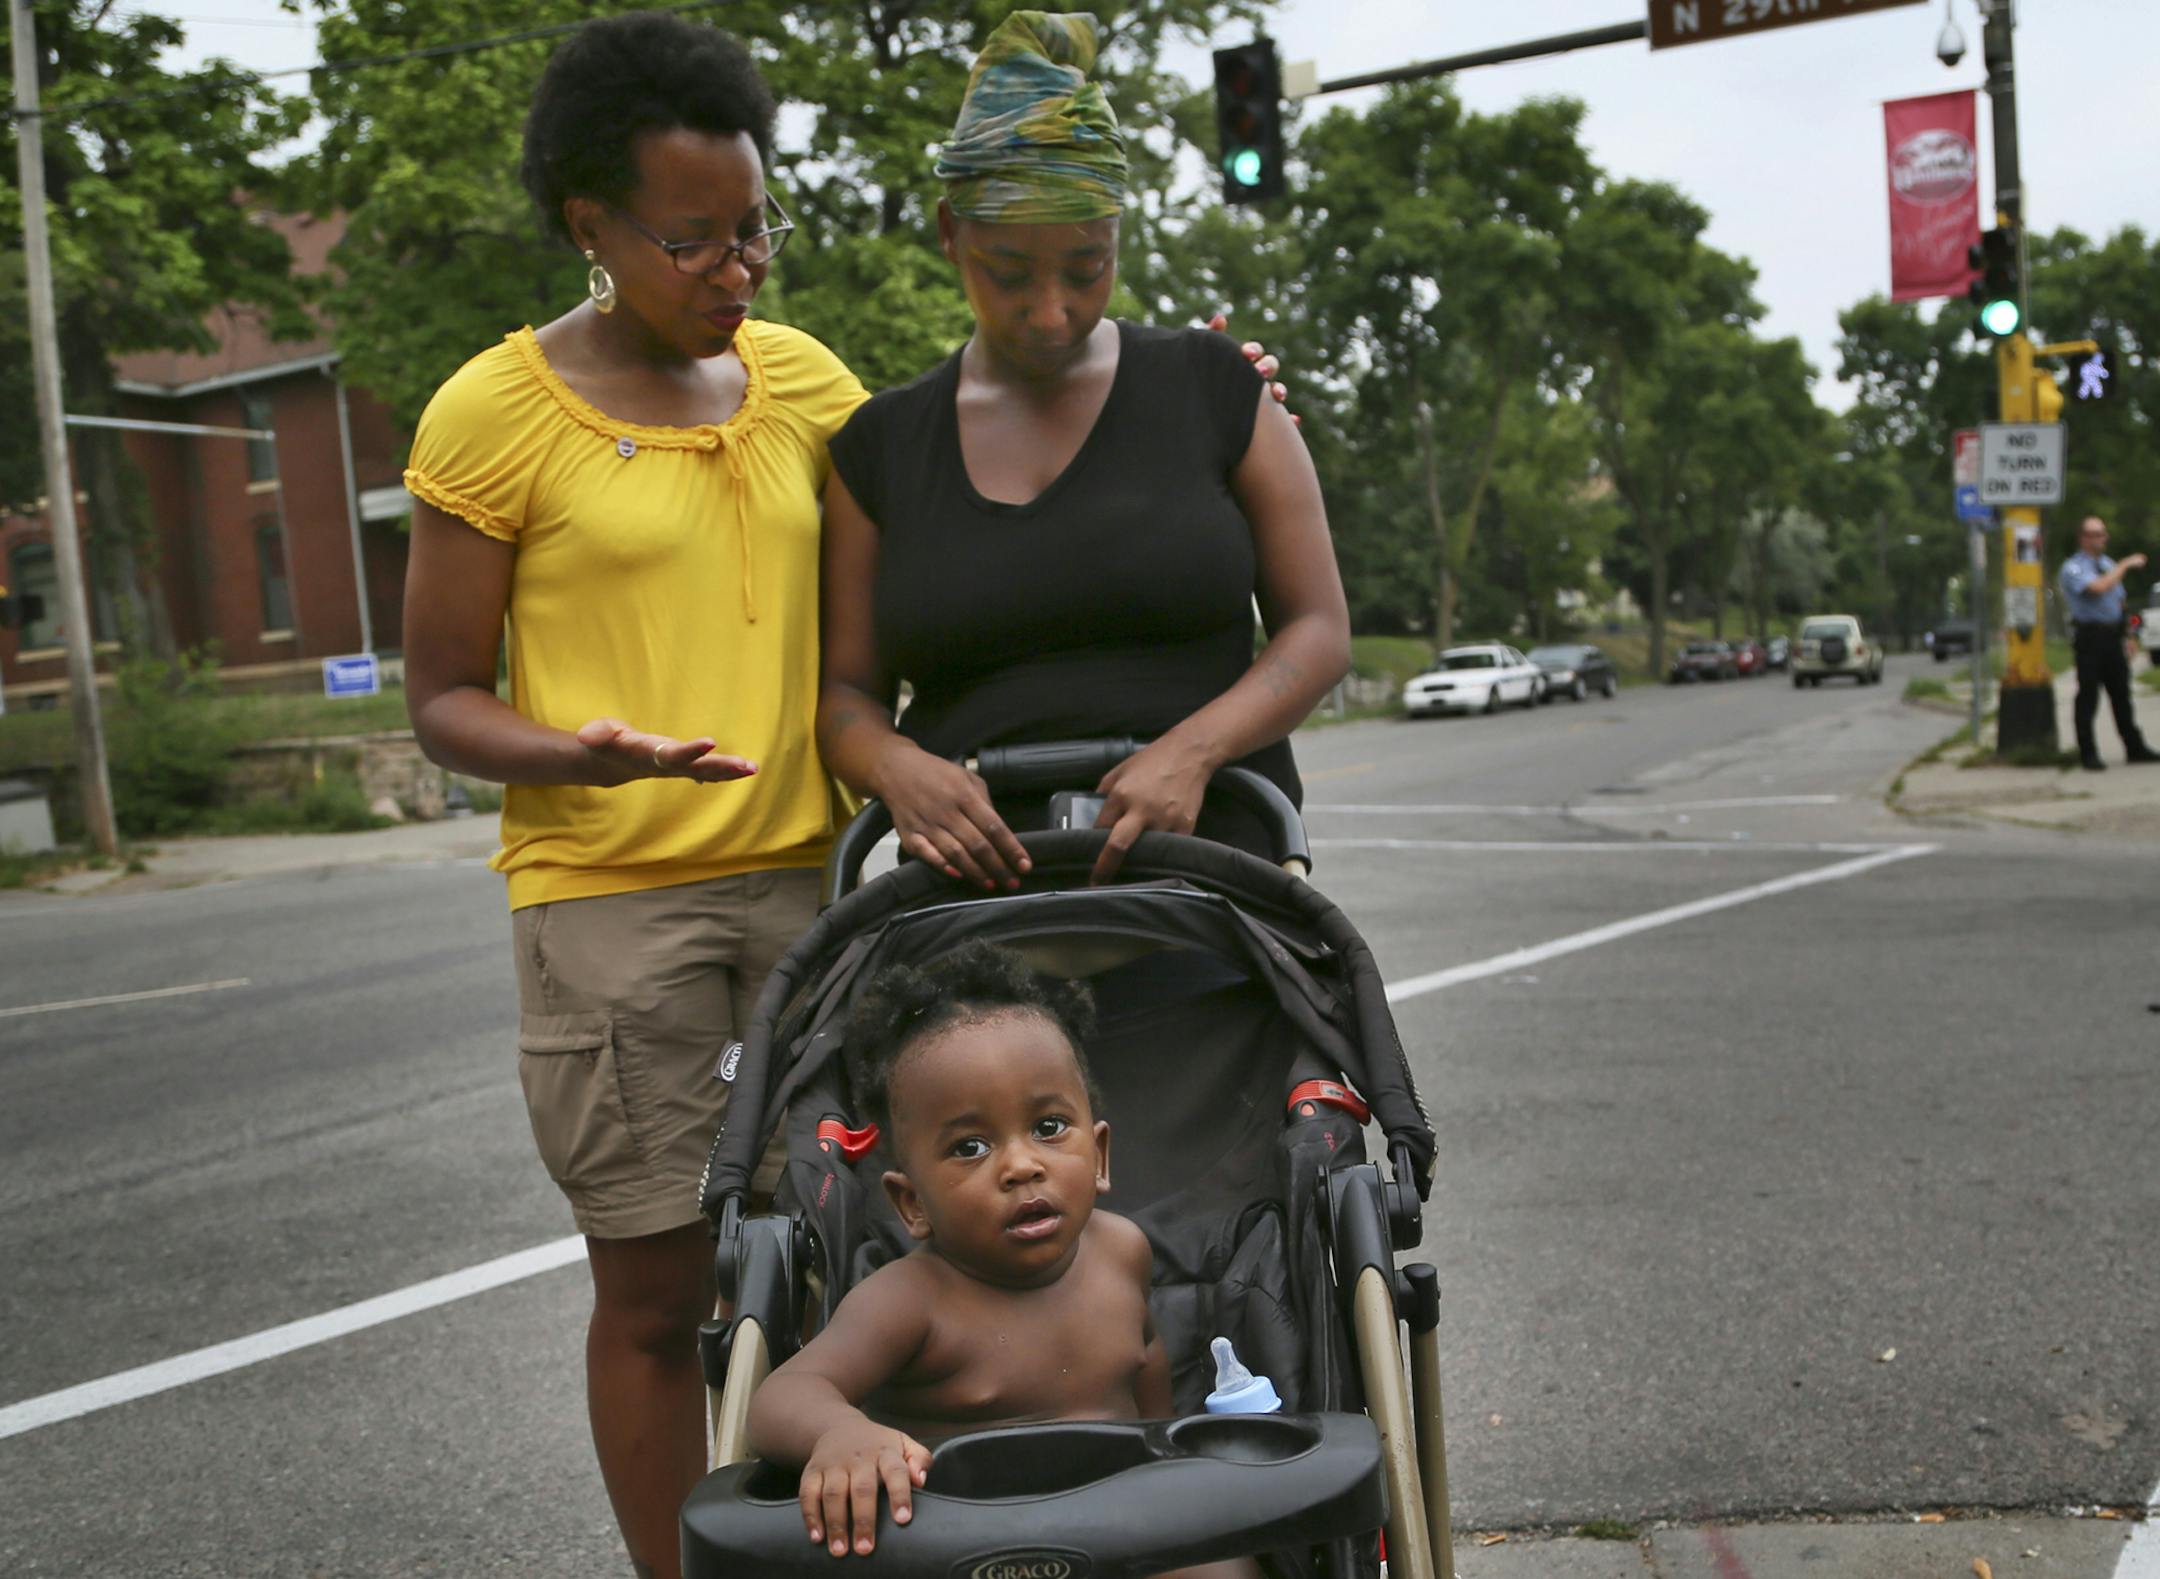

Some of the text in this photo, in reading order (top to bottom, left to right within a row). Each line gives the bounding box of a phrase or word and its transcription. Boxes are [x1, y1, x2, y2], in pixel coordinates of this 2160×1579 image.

[1673, 1, 1699, 34] N
[2007, 431, 2038, 449] NO
[1998, 455, 2047, 473] TURN
[1986, 478, 2058, 496] ON RED
[986, 1562, 1060, 1579] GRACO
